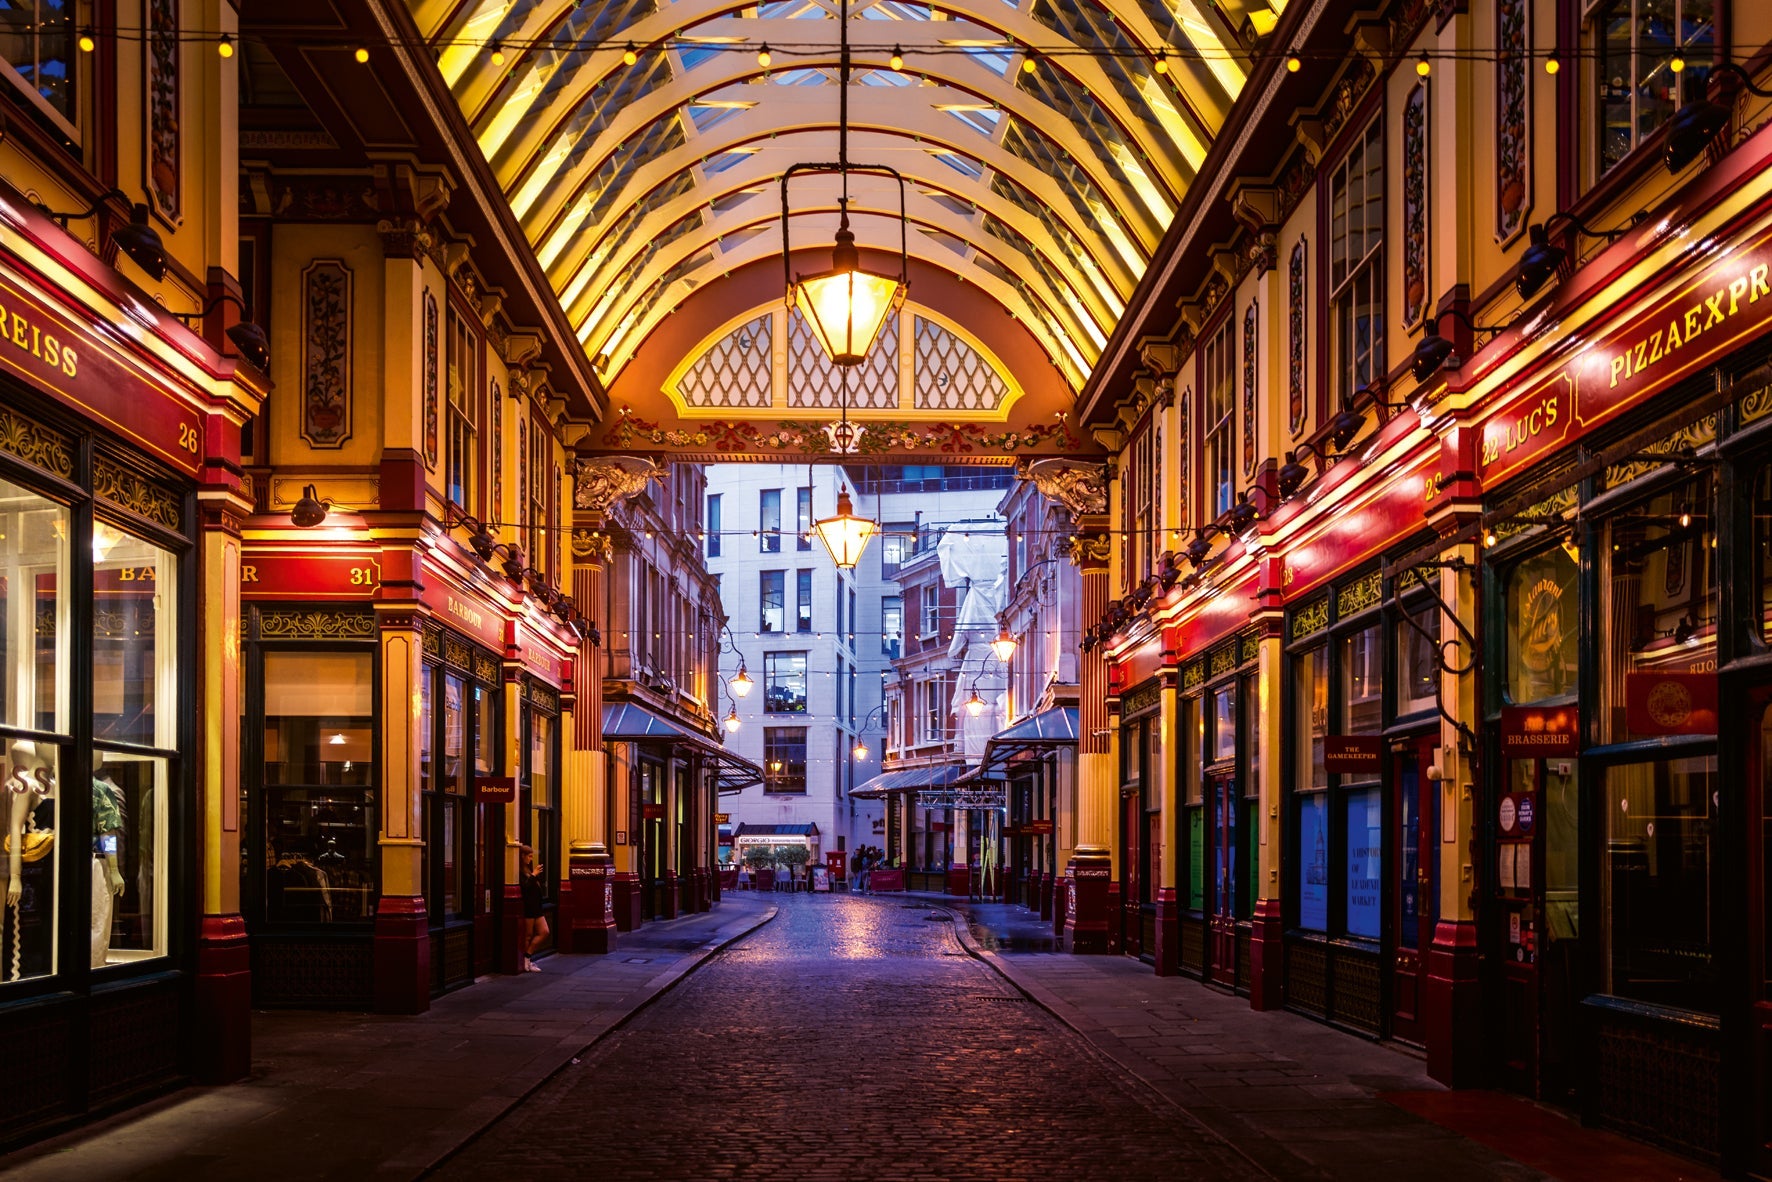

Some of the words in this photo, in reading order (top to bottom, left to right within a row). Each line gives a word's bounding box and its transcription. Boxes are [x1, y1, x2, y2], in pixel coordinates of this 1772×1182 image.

[178, 422, 198, 454] 26
[1481, 439, 1500, 468] 22
[1505, 397, 1558, 453] LUC'S
[350, 566, 373, 586] 31
[447, 595, 482, 630] BARBOUR
[1507, 734, 1570, 745] BRASSERIE
[481, 785, 510, 794] Barbour
[1351, 863, 1359, 873] OF
[1351, 895, 1377, 906] MARKET
